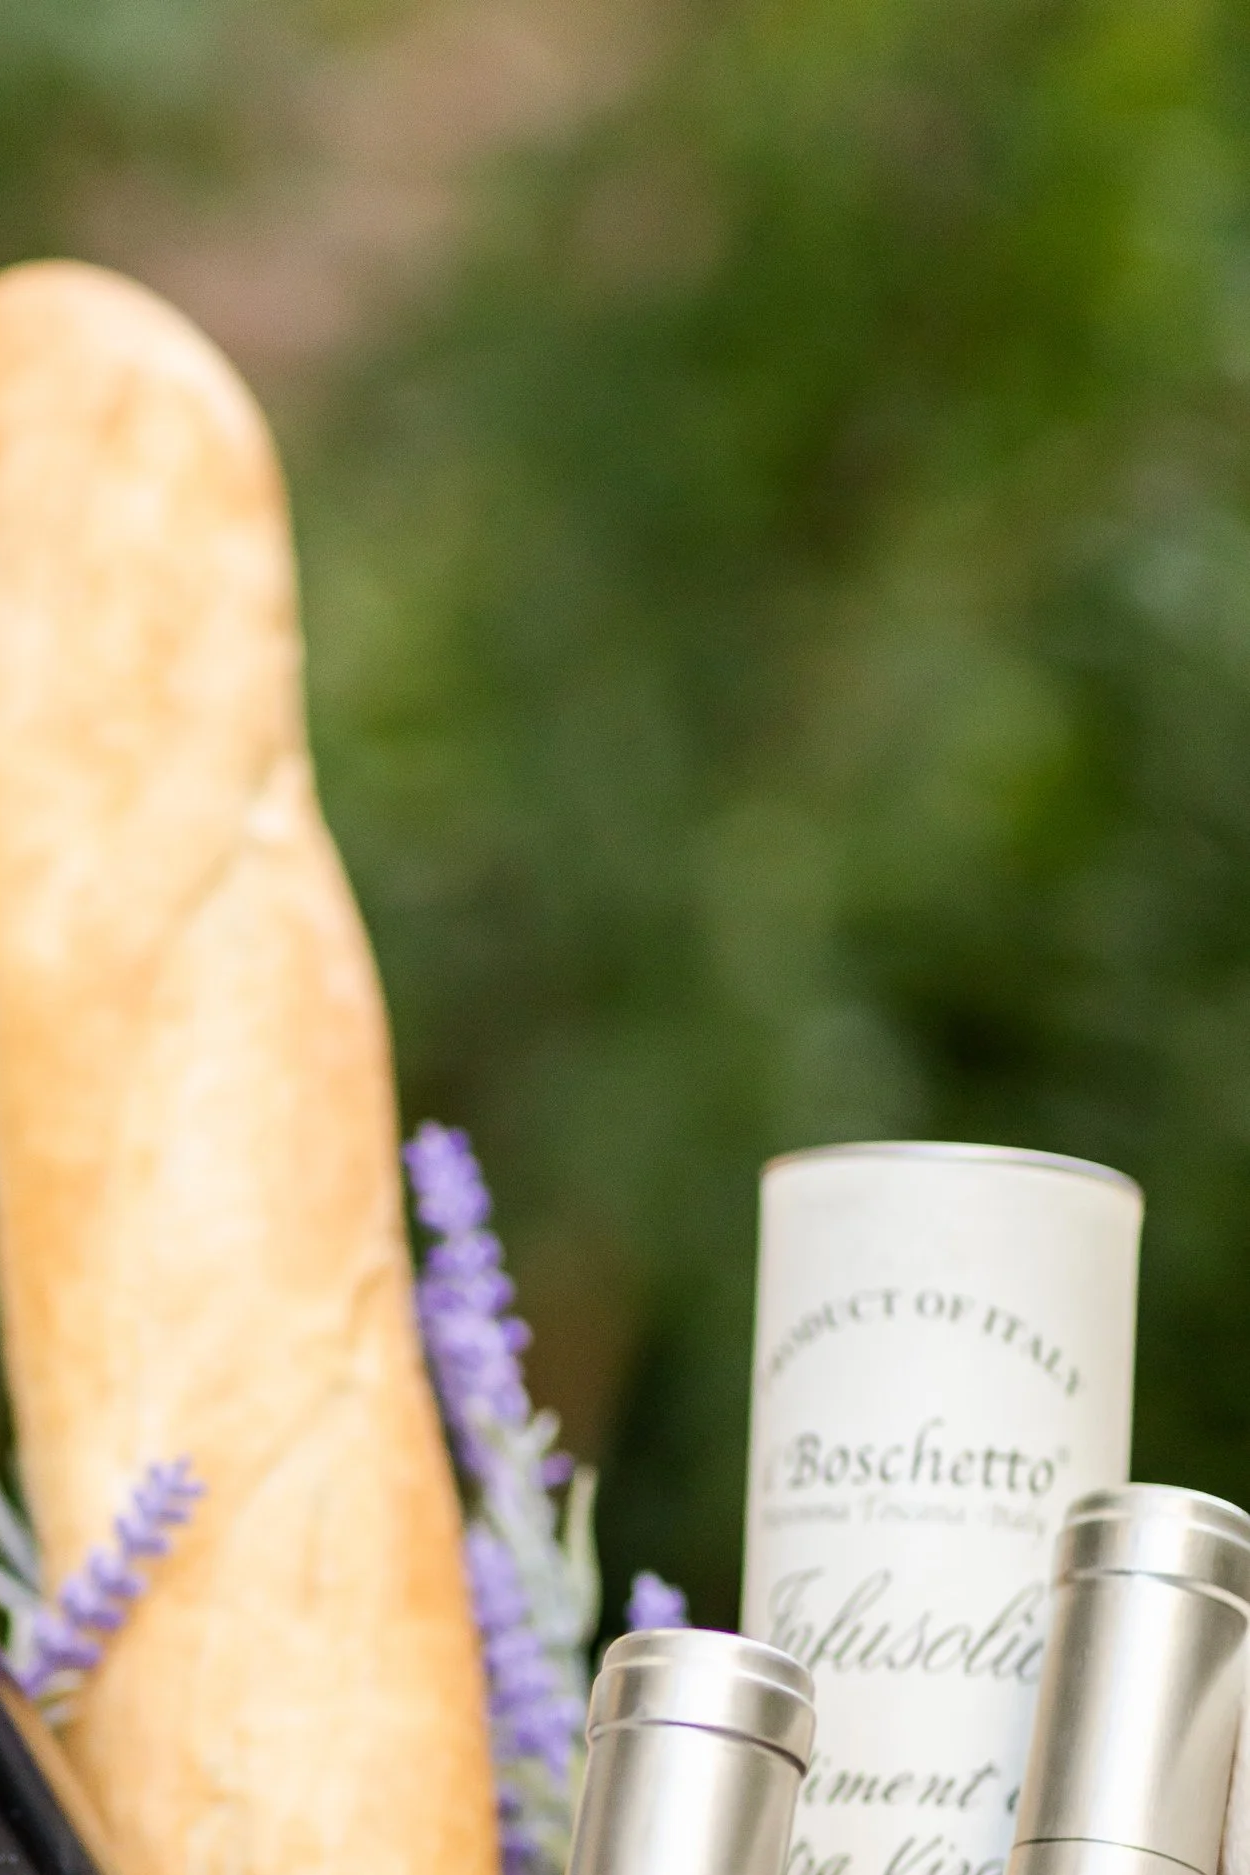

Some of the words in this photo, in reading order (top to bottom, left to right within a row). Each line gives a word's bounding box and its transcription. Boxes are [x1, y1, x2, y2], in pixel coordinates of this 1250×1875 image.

[913, 1290, 972, 1323] OF
[981, 1305, 1086, 1398] ITALY
[784, 1417, 1056, 1497] Boschetto
[803, 1752, 999, 1810] iment
